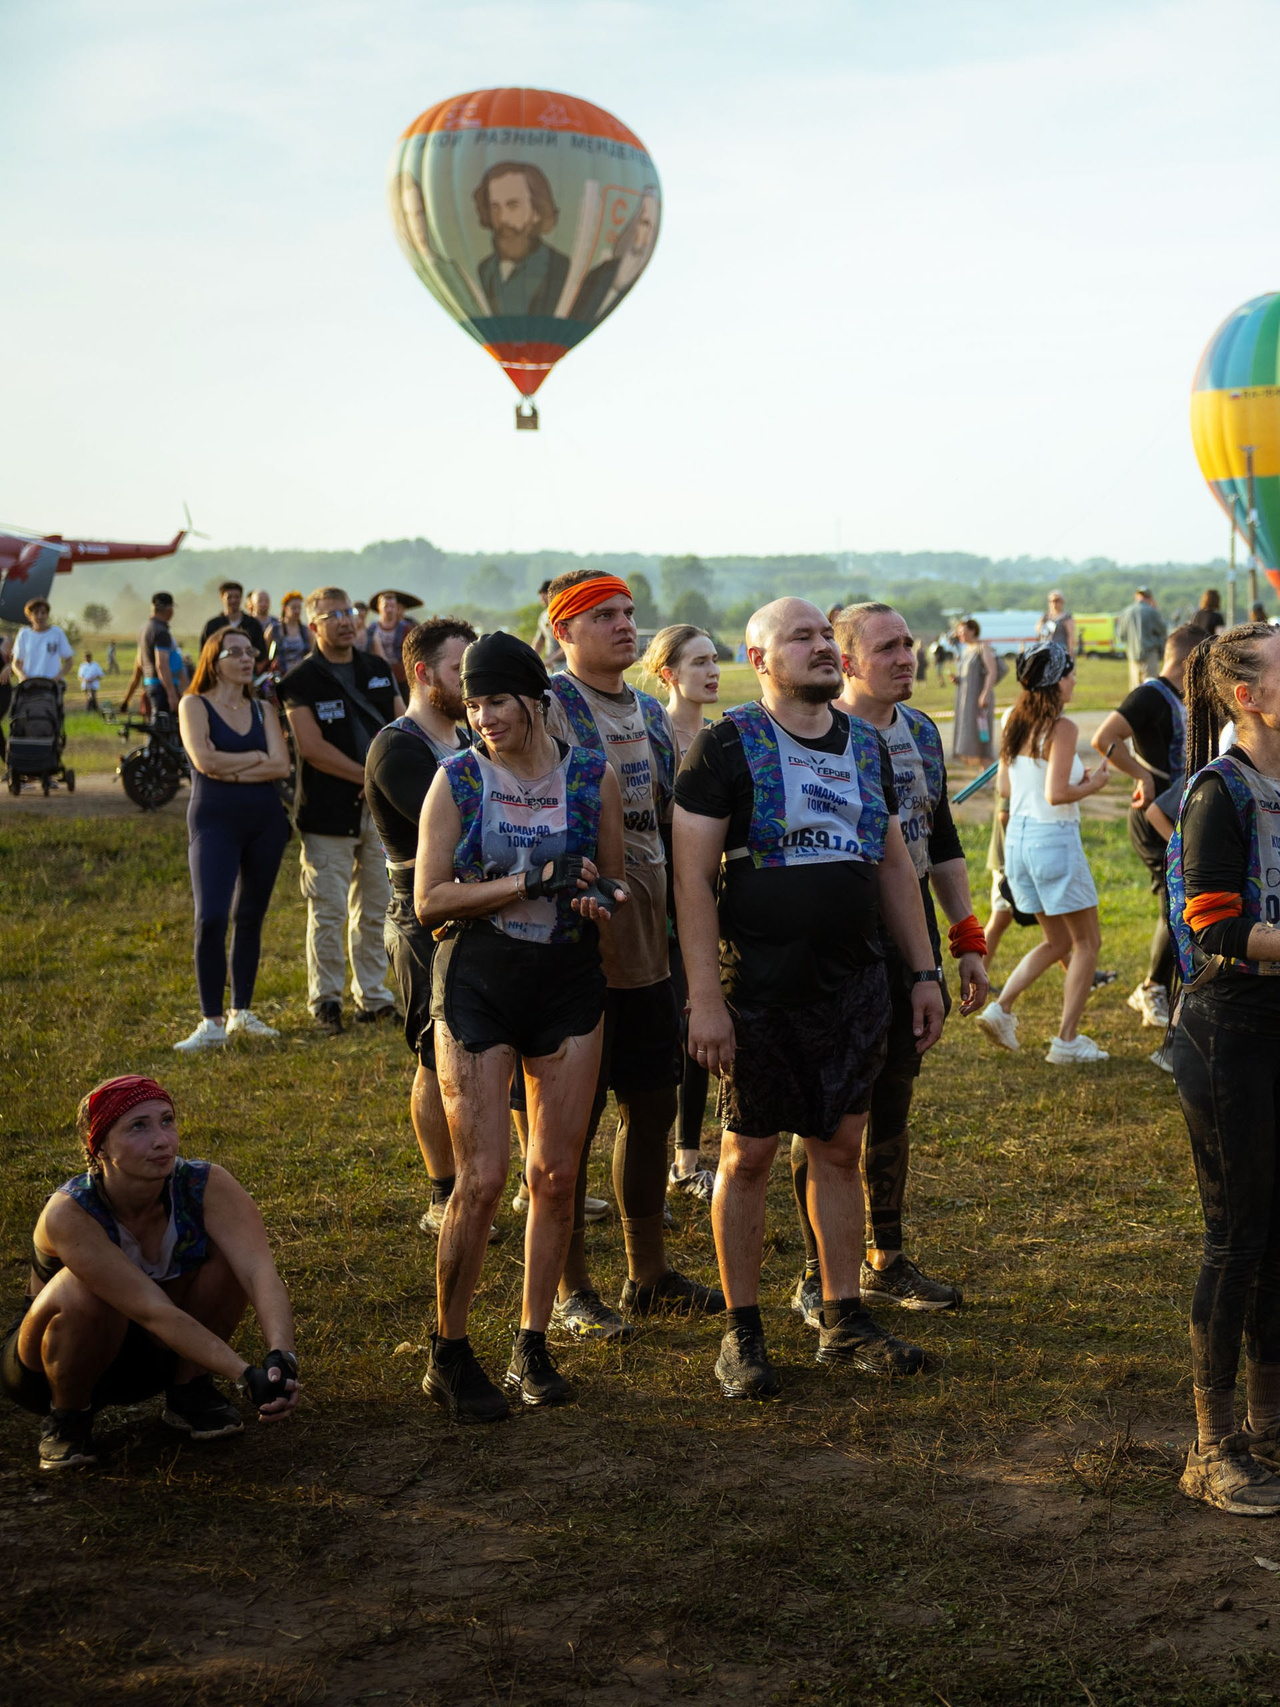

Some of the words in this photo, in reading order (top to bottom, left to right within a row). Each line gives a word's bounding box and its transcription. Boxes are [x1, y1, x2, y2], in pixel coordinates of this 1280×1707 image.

[475, 128, 558, 148] РАЗНЫЙ
[606, 733, 632, 742] ГОНКА
[621, 760, 650, 774] КОМАН
[818, 767, 851, 780] ГЕРОЕВ
[490, 790, 521, 804] ГОНКА
[801, 783, 848, 807] КОМАНДА
[807, 797, 838, 814] 10КМ+
[499, 821, 551, 837] КОМАНДА
[507, 835, 542, 849] 10КМ+
